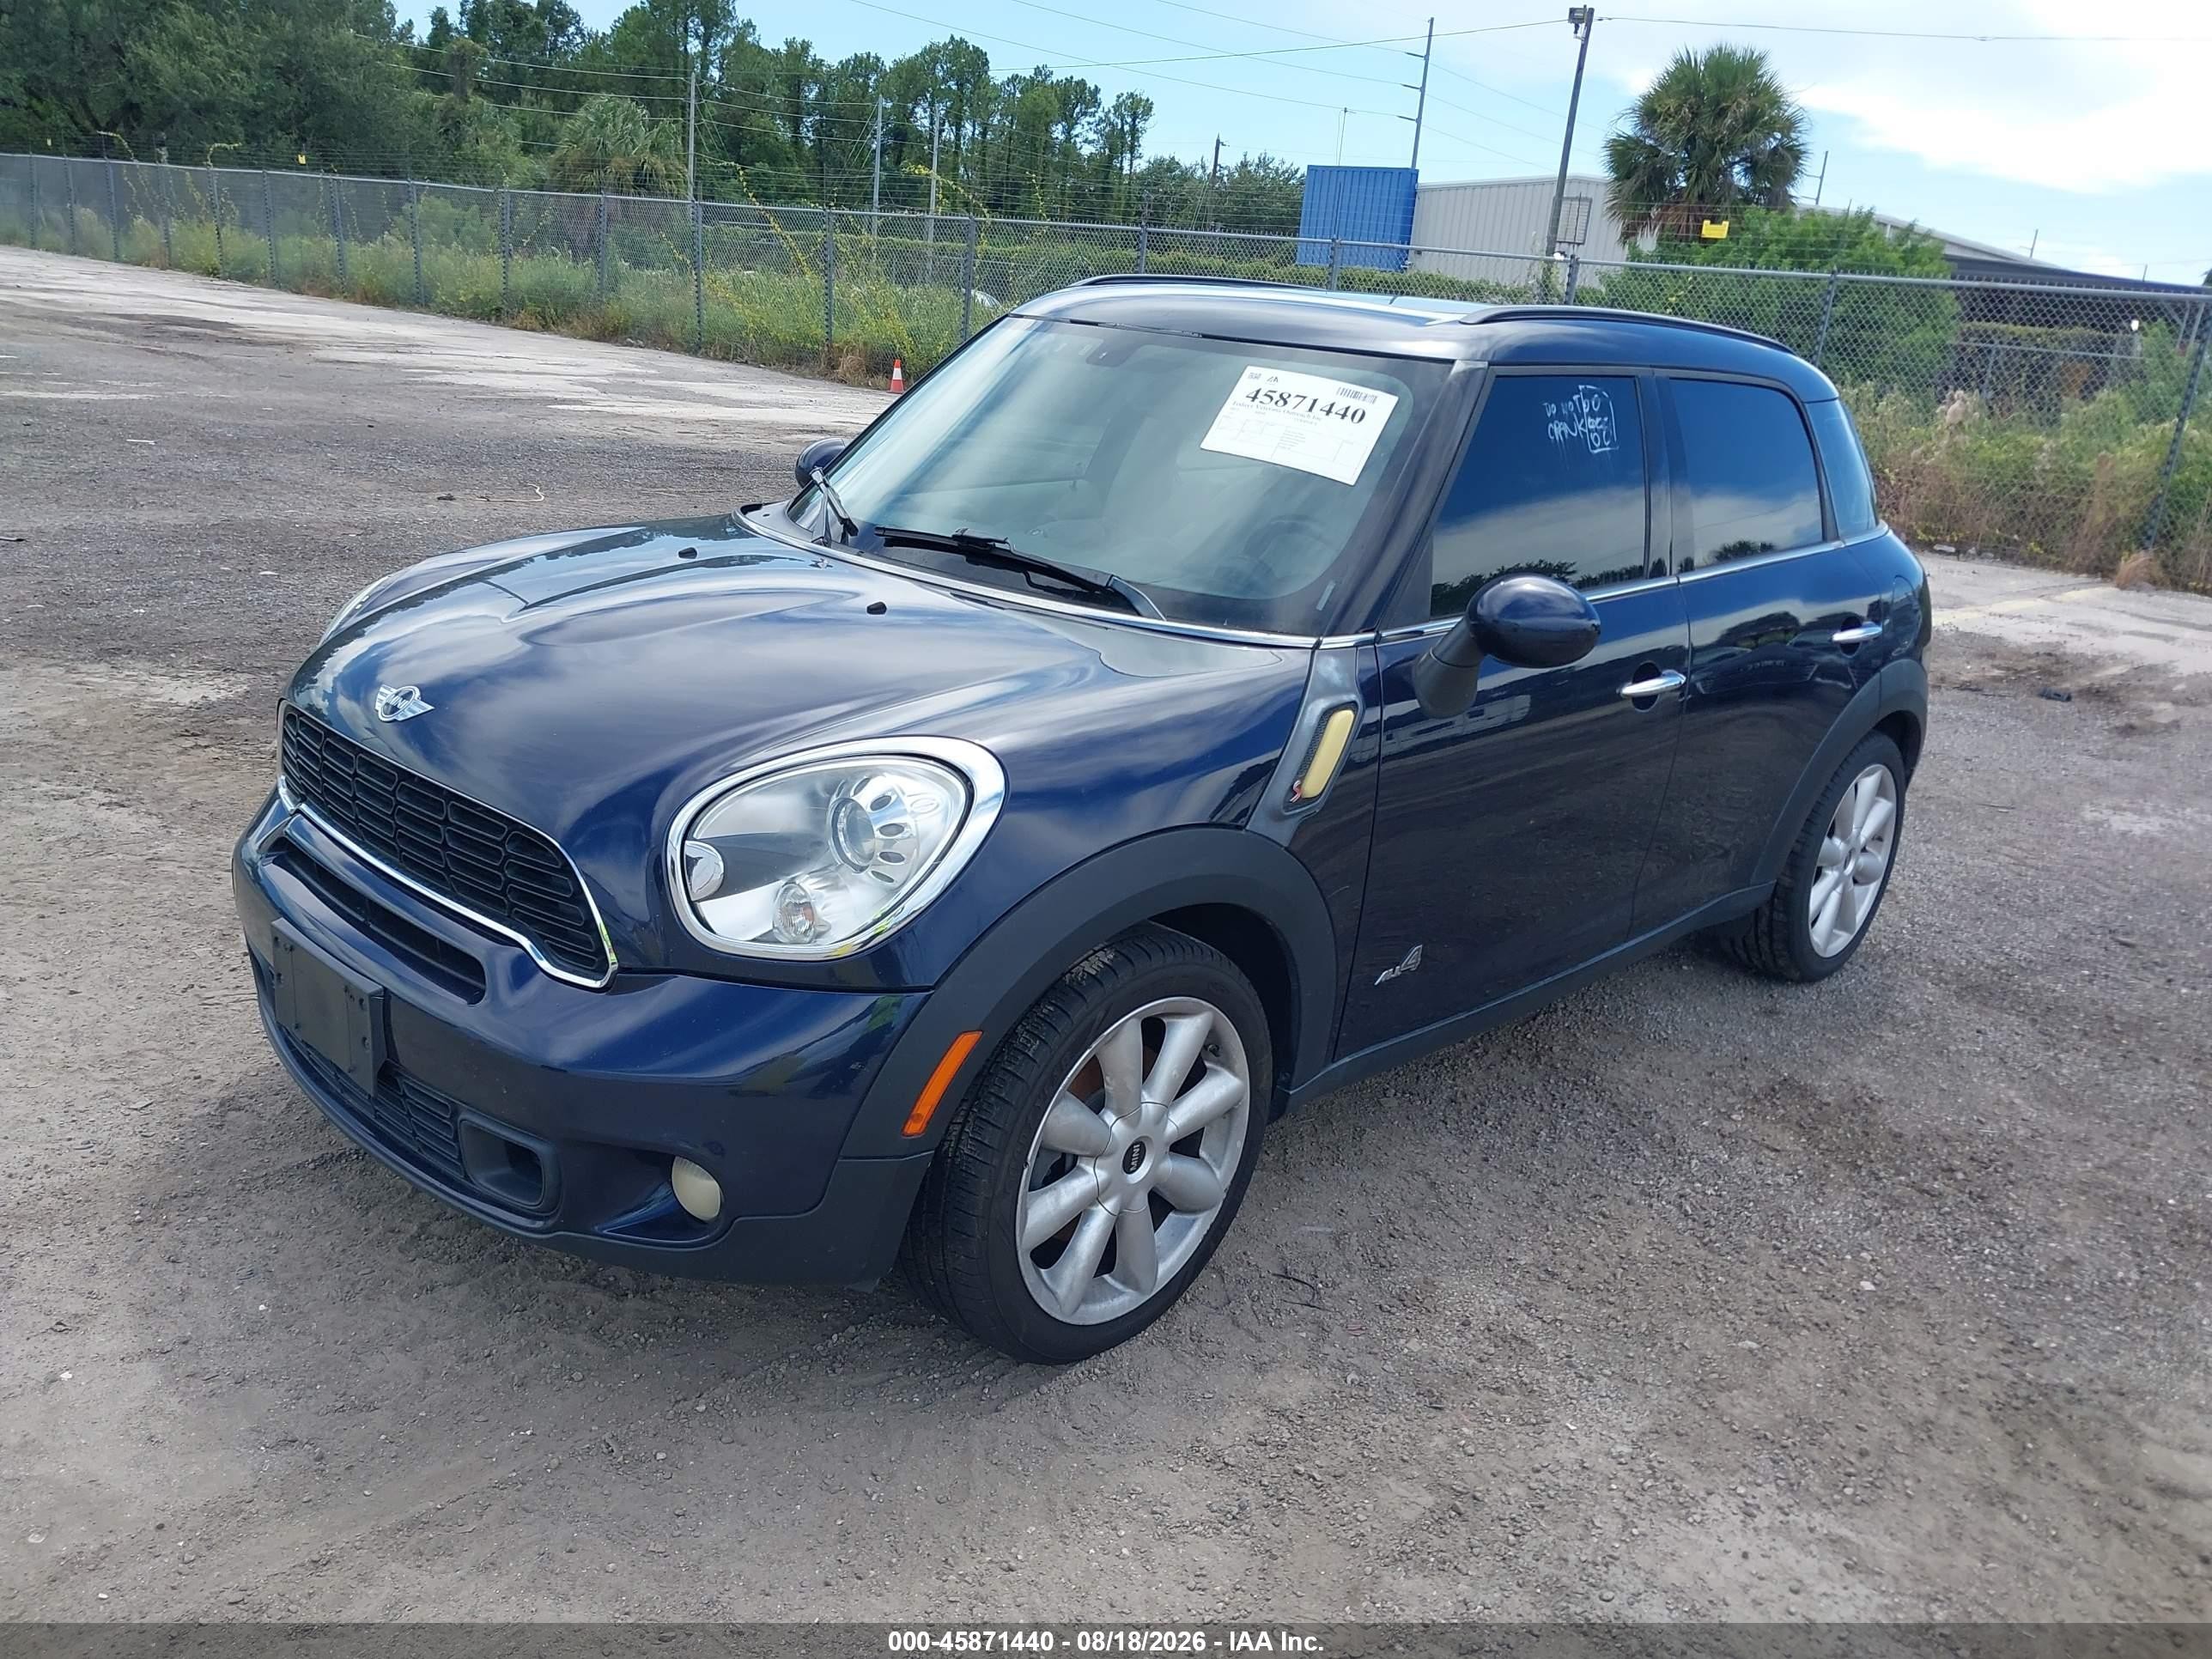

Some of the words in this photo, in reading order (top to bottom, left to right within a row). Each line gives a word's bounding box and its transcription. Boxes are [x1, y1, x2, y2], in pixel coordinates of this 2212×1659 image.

[1245, 387, 1366, 424] 45871440
[1543, 403, 1557, 417] DO
[1130, 1145, 1140, 1170] MINI
